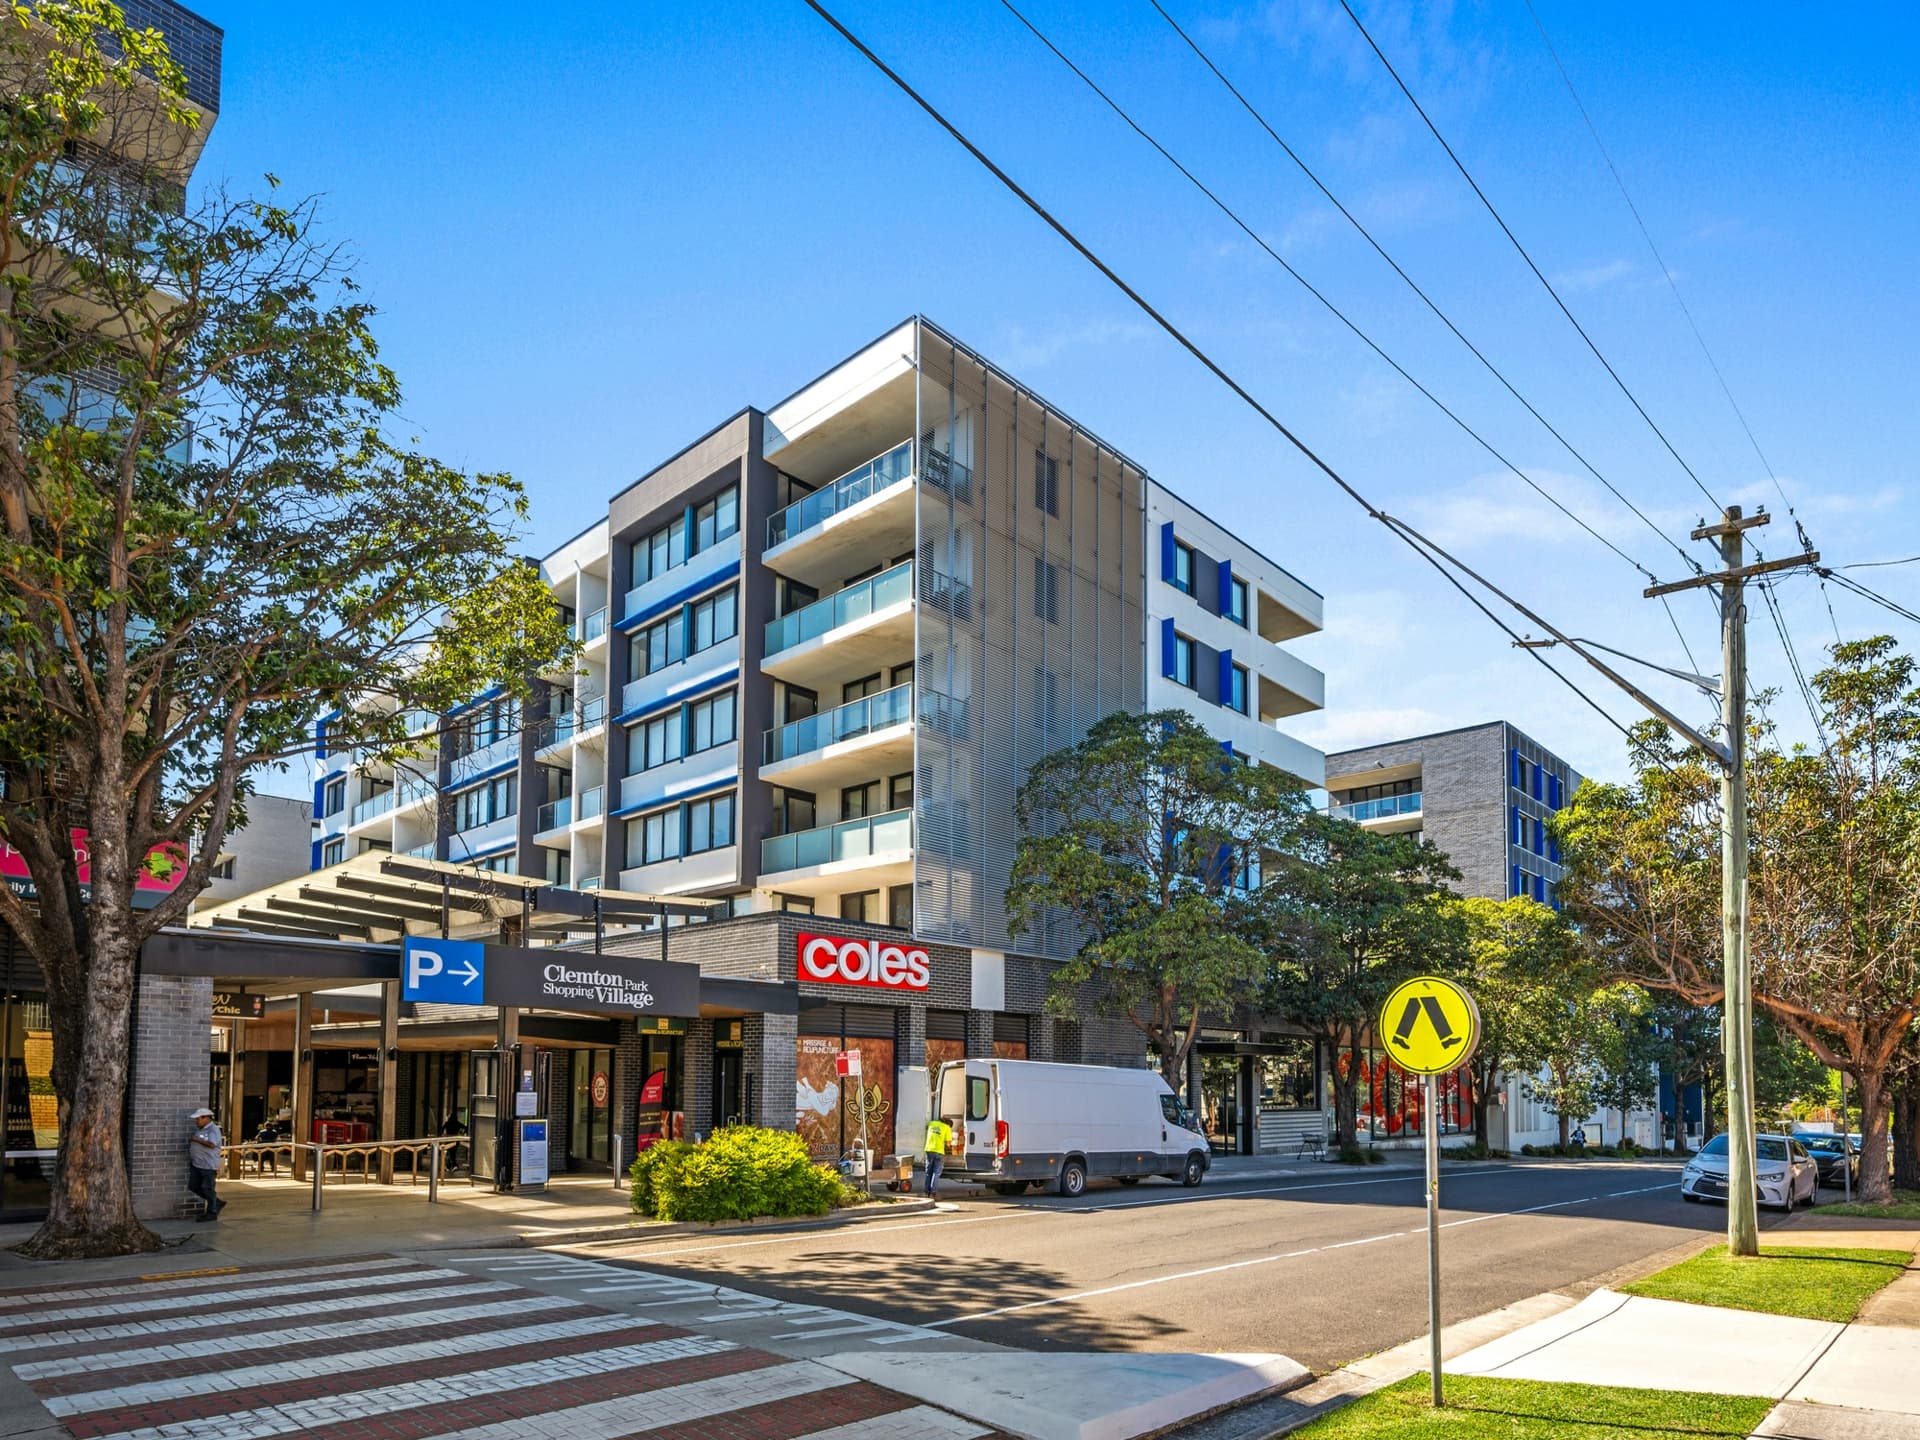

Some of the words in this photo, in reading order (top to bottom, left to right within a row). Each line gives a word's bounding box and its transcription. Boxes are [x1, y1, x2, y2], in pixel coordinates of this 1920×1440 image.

[408, 950, 443, 989] P
[543, 964, 624, 987] Clemton
[625, 979, 649, 992] Park
[803, 938, 930, 987] coles
[543, 983, 594, 998] Shopping
[595, 986, 654, 1008] Village
